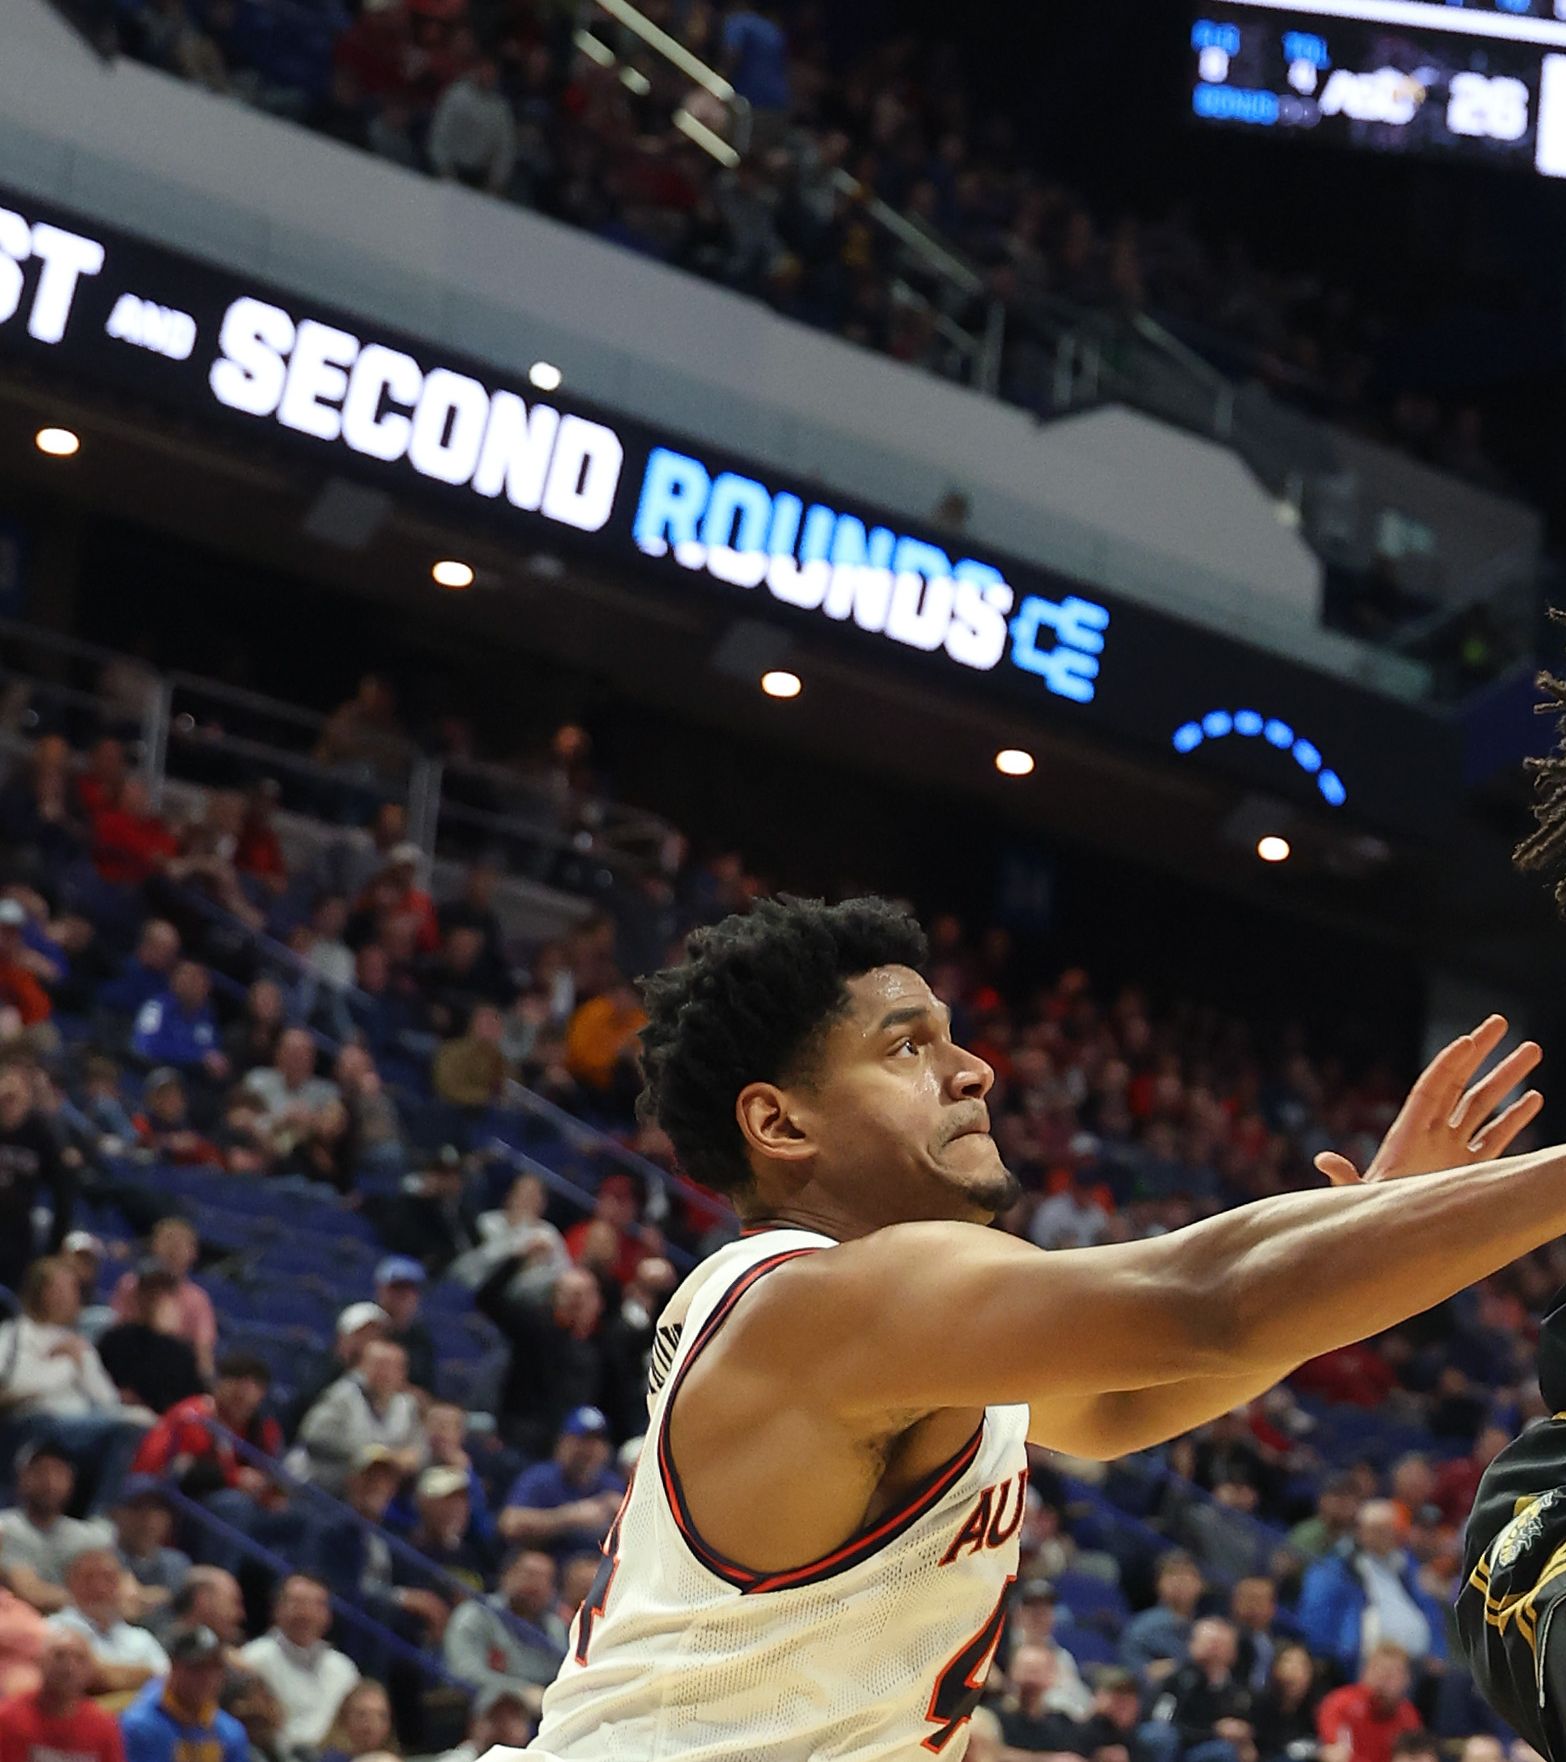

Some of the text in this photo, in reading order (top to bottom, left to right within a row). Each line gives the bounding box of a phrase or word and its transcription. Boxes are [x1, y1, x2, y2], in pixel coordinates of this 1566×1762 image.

[106, 293, 197, 360] AND
[209, 296, 624, 532] SECOND
[632, 447, 1014, 672] ROUNDS
